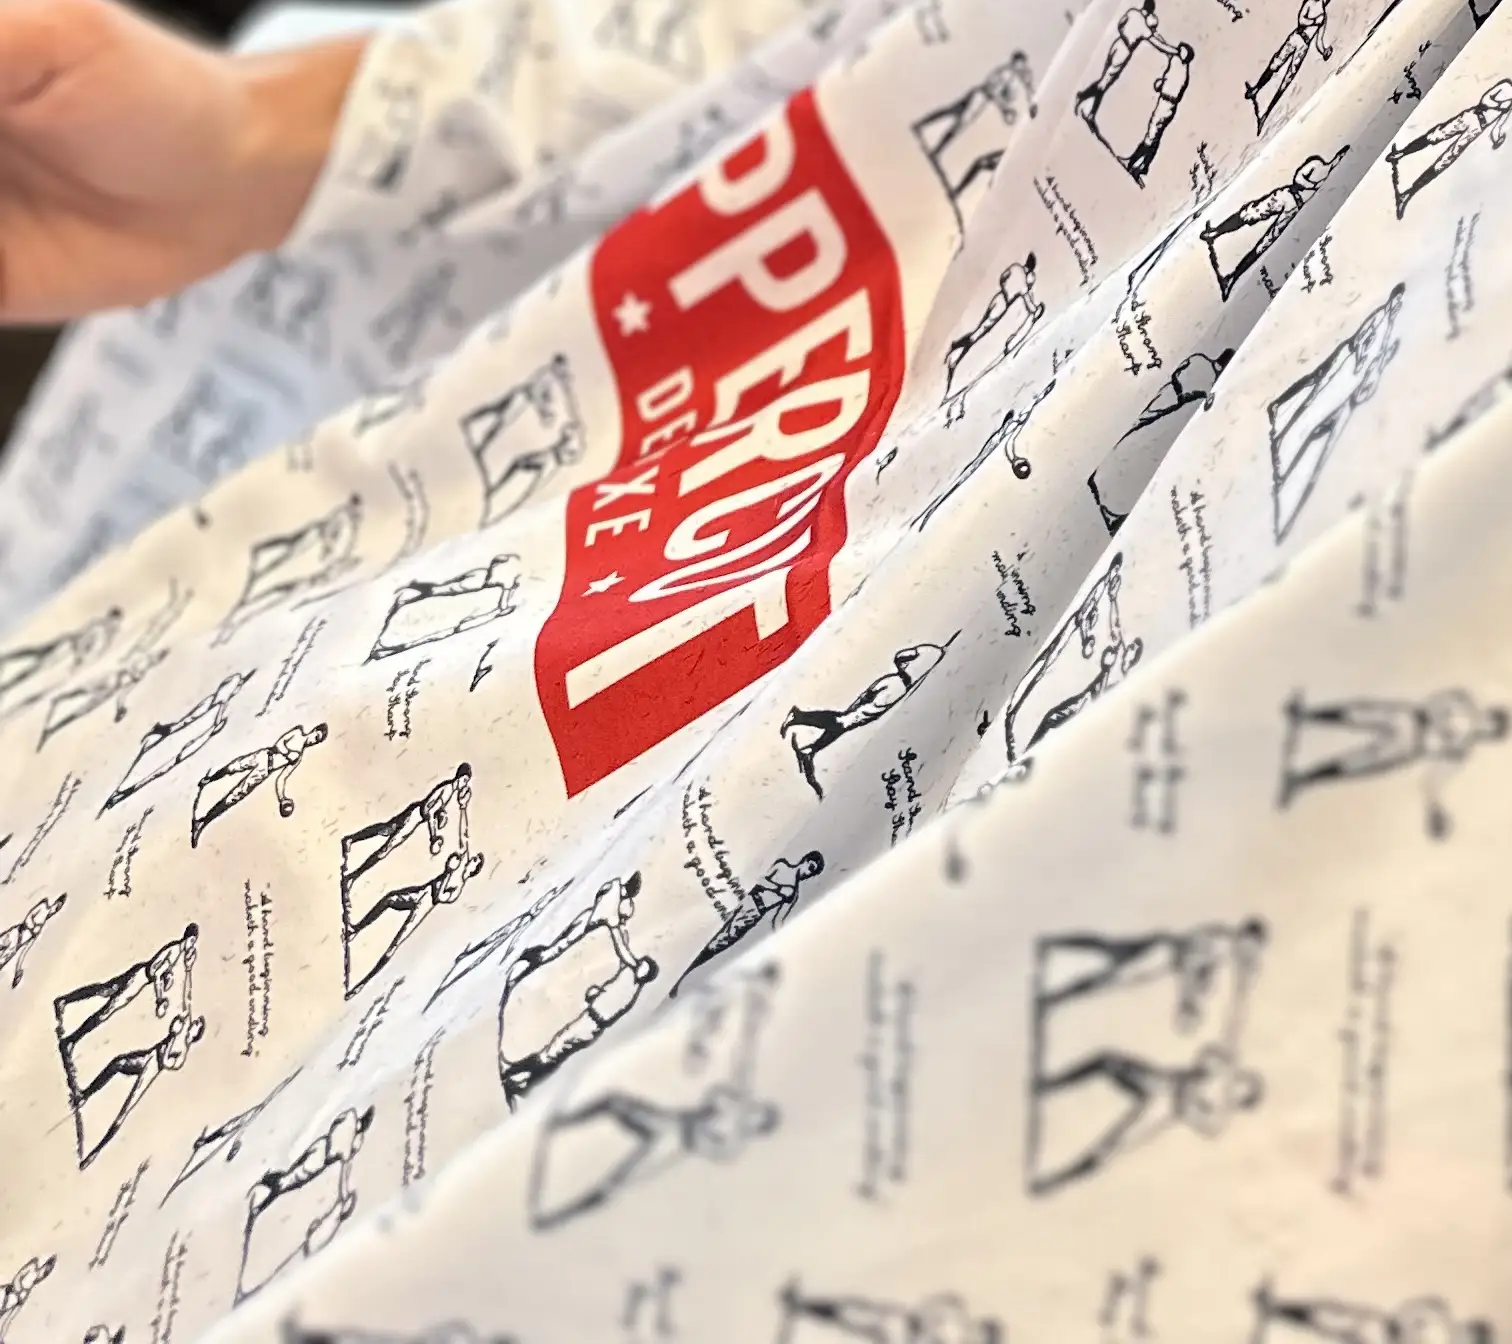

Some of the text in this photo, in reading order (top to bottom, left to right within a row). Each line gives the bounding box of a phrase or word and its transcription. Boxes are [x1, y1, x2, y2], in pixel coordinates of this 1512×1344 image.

[1115, 320, 1143, 377] Sharp
[584, 365, 698, 547] DEXE
[685, 839, 696, 855] a
[698, 803, 725, 850] hard
[683, 855, 727, 900] good
[247, 939, 255, 952] a
[260, 909, 274, 951] hard
[241, 953, 263, 997] good
[255, 951, 275, 1038] beginning
[240, 997, 261, 1058] ending
